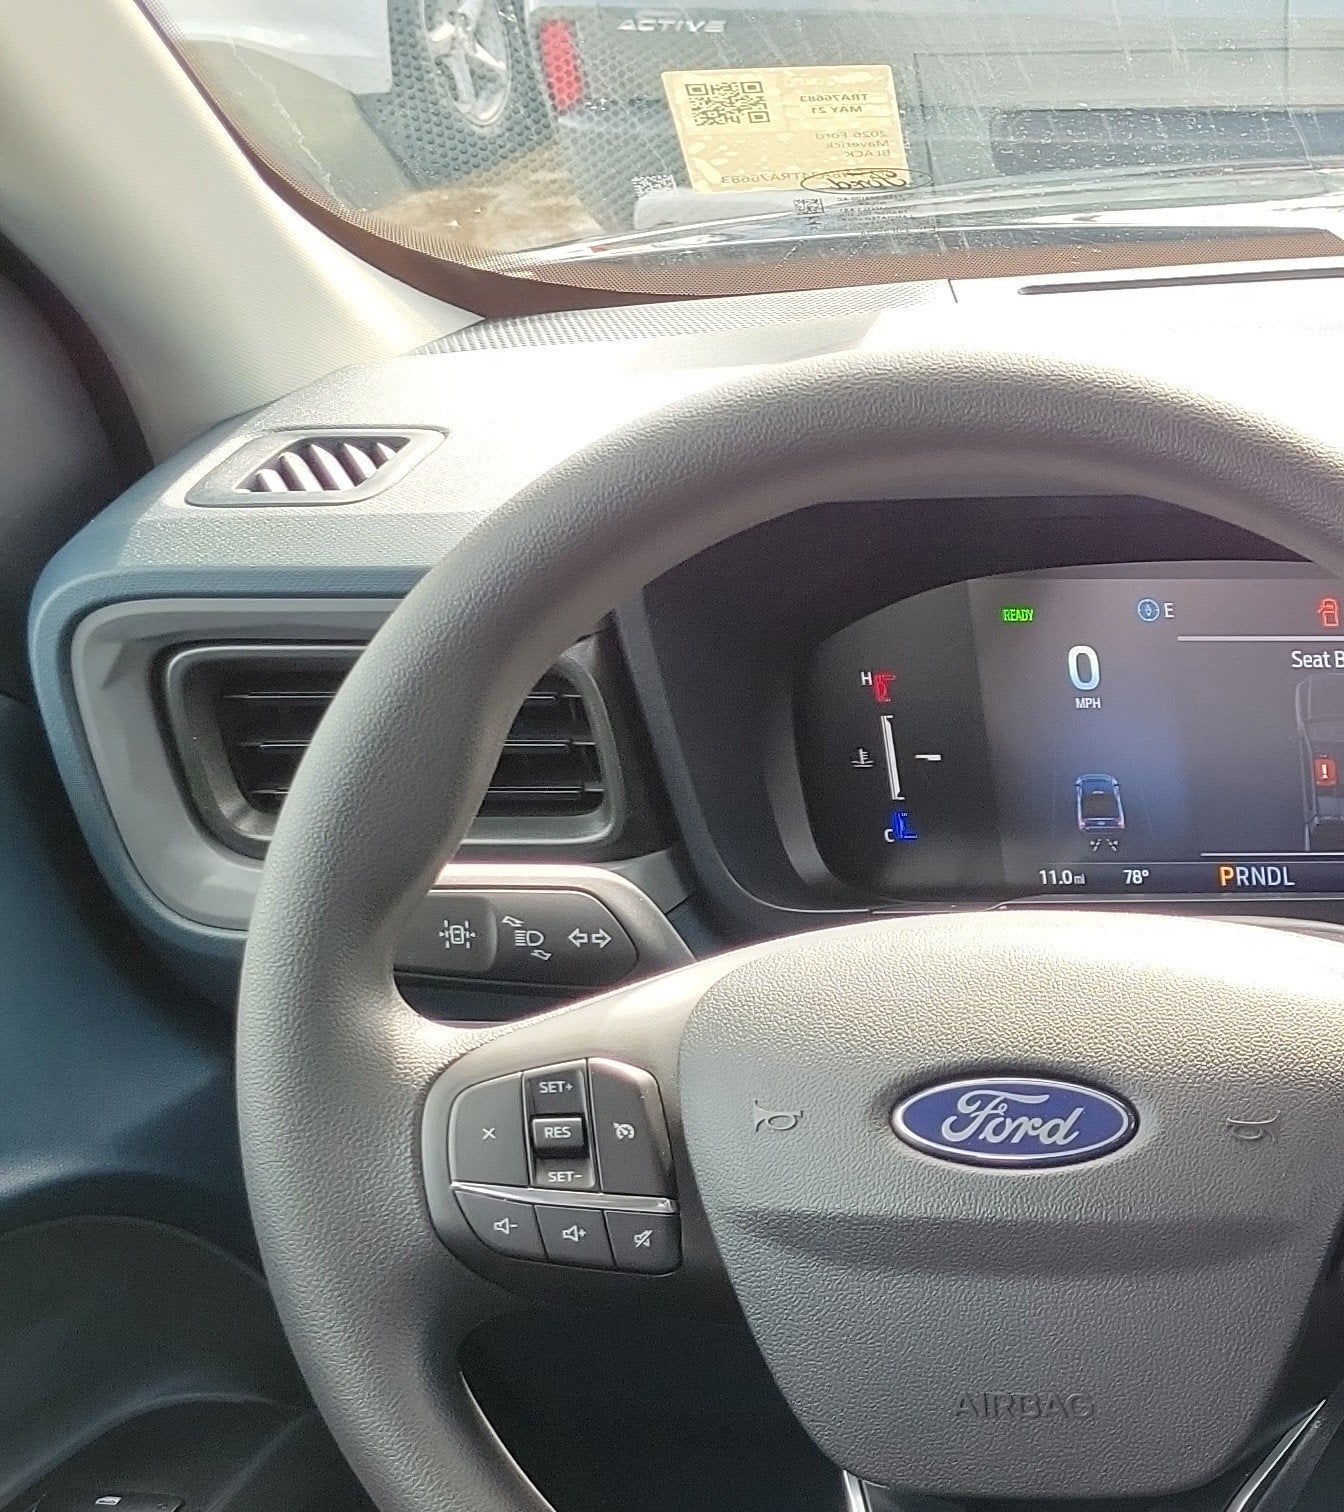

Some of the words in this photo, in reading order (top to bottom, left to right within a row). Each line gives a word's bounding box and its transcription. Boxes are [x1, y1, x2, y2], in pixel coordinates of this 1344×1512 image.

[617, 18, 729, 34] ACTIVE
[1002, 608, 1034, 622] READY
[1164, 603, 1175, 618] E
[1291, 650, 1332, 669] Seat
[1067, 645, 1100, 690] 0
[861, 671, 873, 686] H
[1074, 697, 1102, 709] MPH
[884, 828, 895, 843] C
[1122, 868, 1150, 885] 78°
[539, 1081, 574, 1094] SET+
[941, 1089, 1085, 1146] Ford
[544, 1126, 571, 1139] RES
[955, 1391, 1096, 1420] AIRBAG
